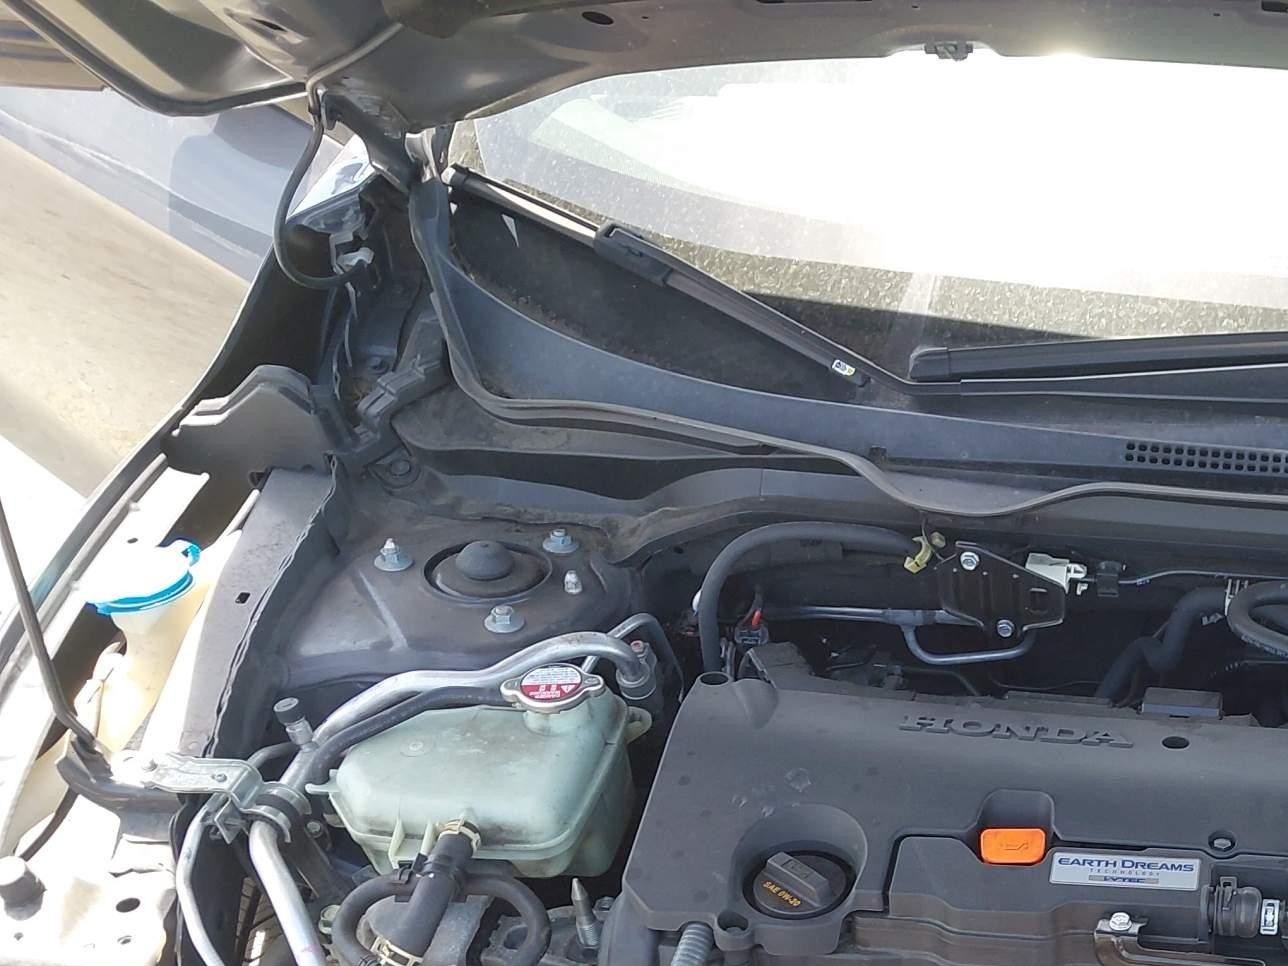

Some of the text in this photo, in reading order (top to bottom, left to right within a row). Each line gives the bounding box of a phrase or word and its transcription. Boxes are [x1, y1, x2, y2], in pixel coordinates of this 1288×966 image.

[899, 715, 1134, 748] HONDA
[1058, 857, 1194, 872] EARTH DREAMS
[1090, 868, 1160, 876] TECHNOLOGY
[763, 881, 781, 894] SAE
